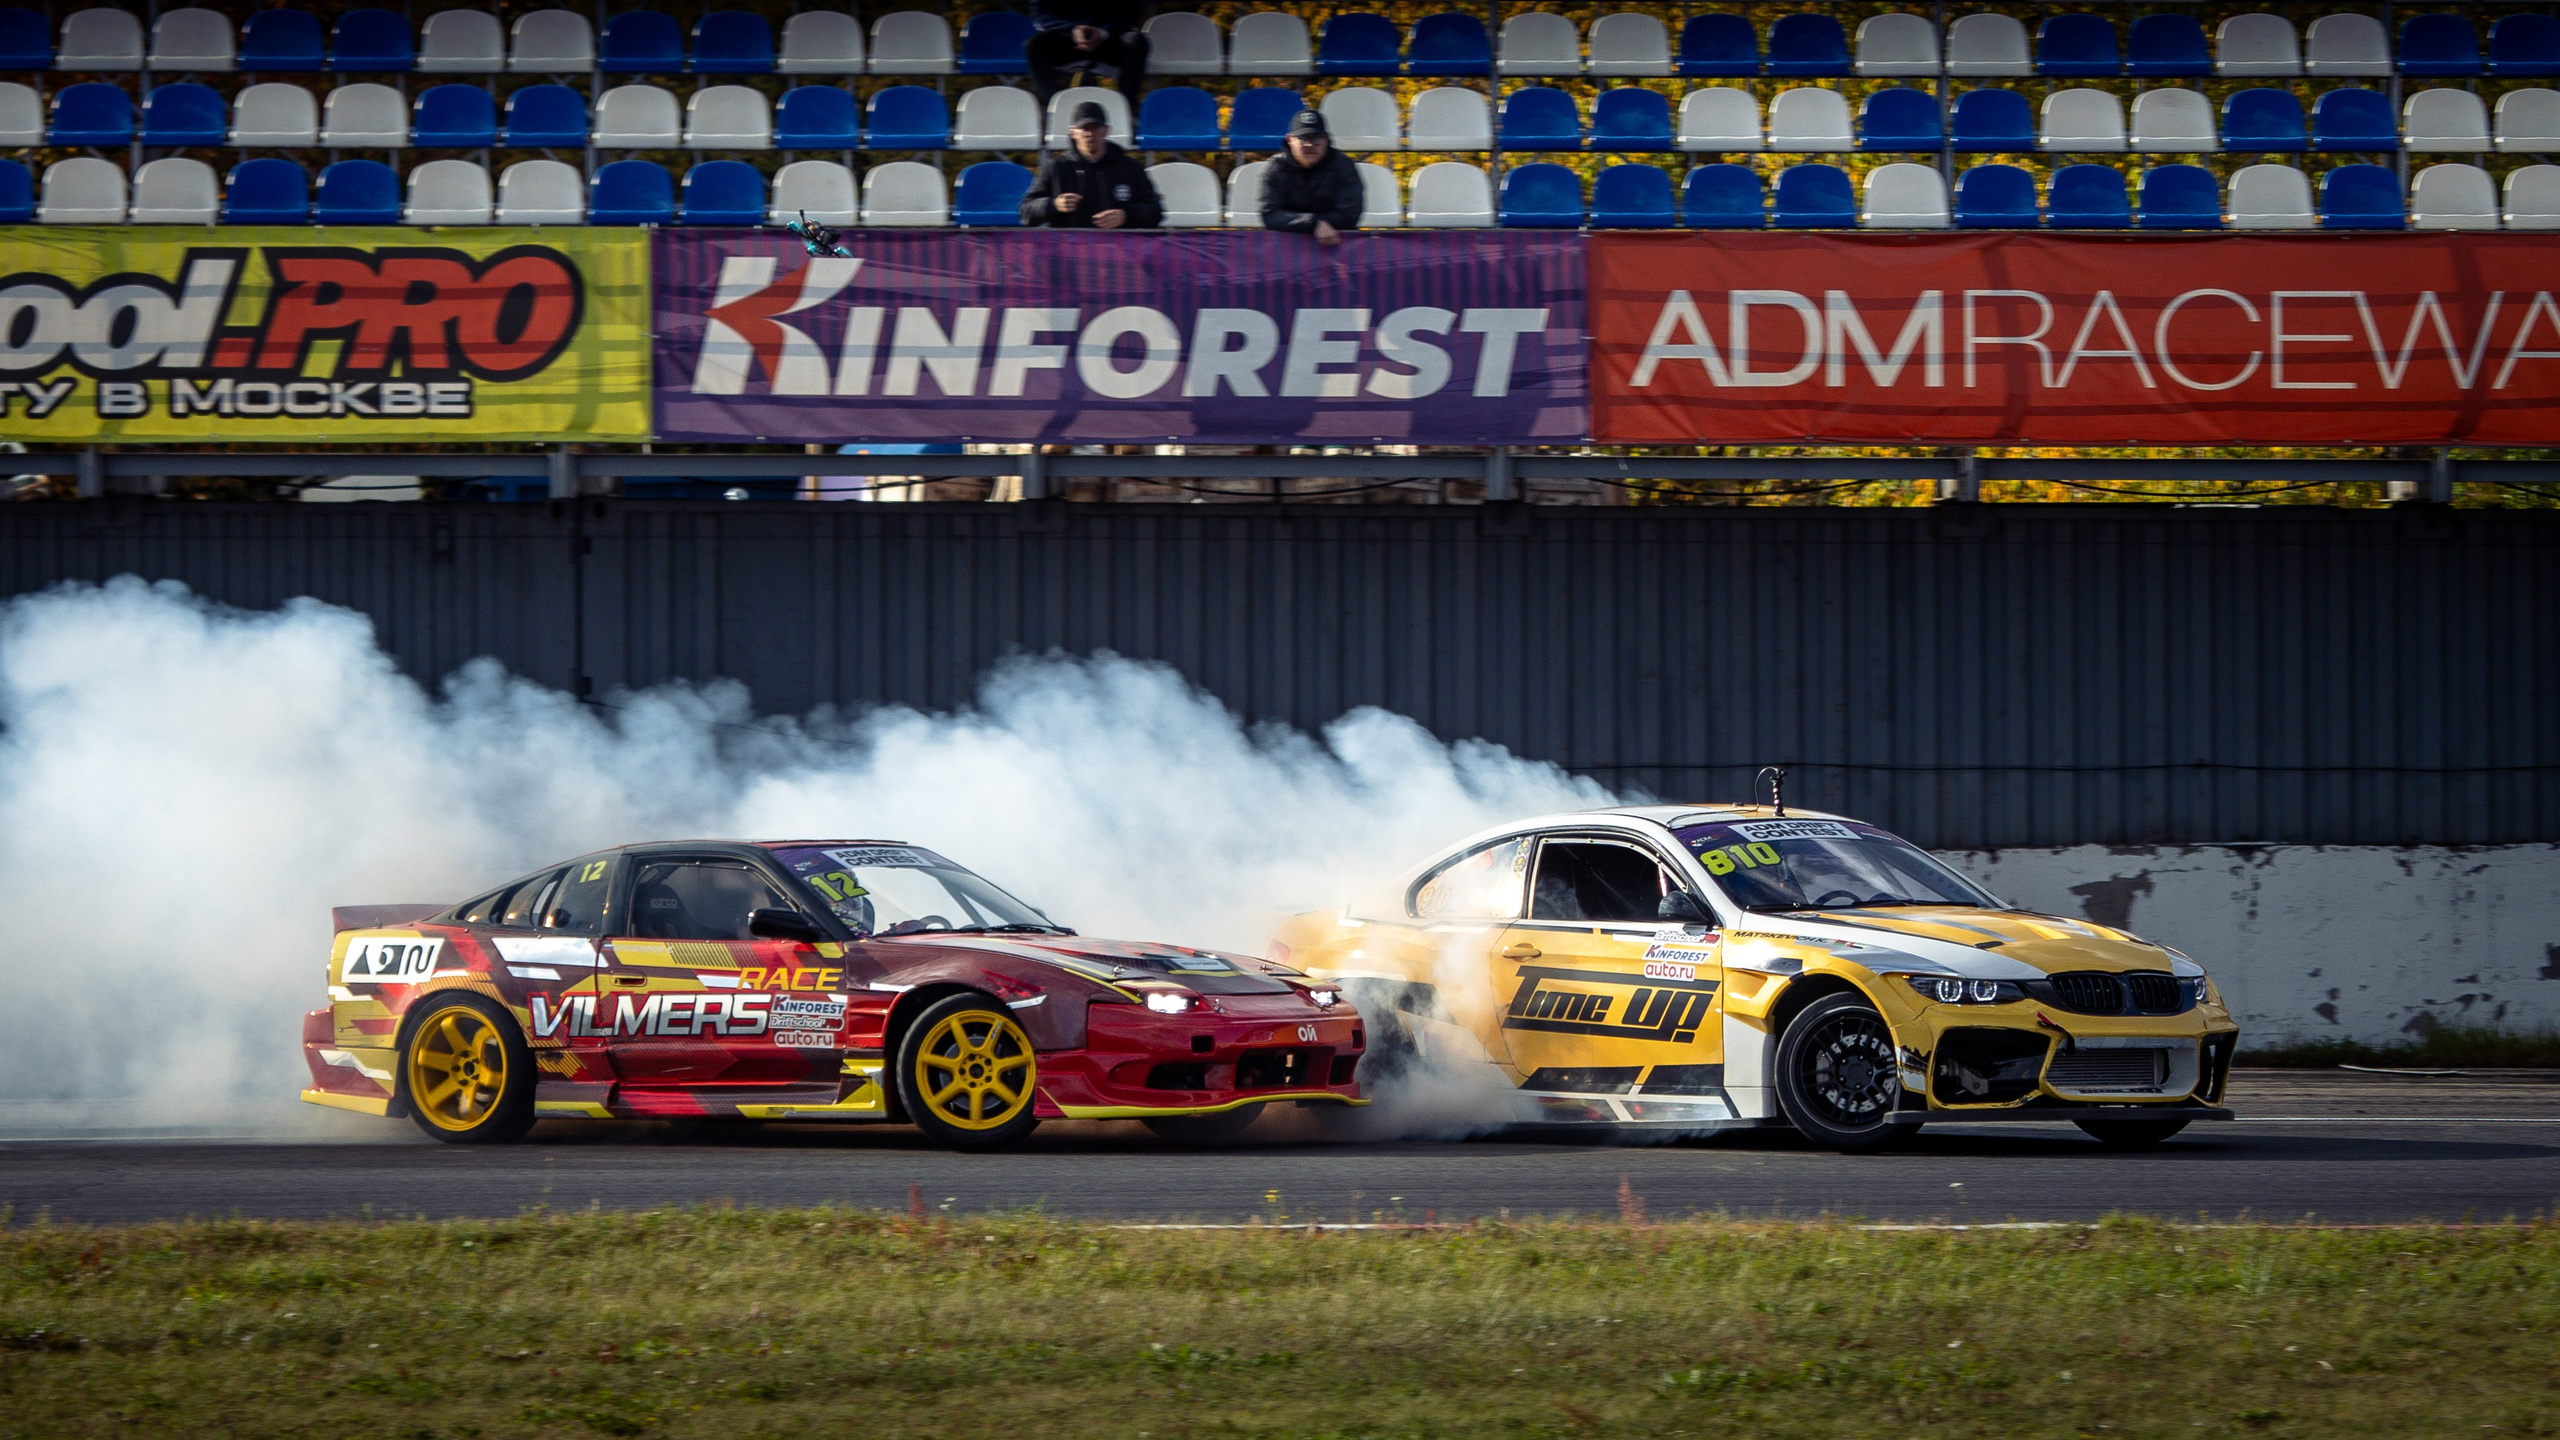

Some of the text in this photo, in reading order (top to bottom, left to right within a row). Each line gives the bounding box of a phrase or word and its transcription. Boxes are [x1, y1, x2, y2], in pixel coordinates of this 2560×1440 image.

[690, 256, 1550, 399] KINFOREST
[100, 380, 148, 414] В
[1743, 822, 1836, 833] ADM DRIFT
[1750, 828, 1848, 839] CONTEST
[835, 849, 873, 858] ADM
[844, 855, 922, 866] CONTEST
[1699, 842, 1781, 876] 810
[579, 861, 607, 883] 12
[810, 871, 869, 901] 12
[1733, 931, 1815, 942] MATSKEVICH
[1645, 944, 1709, 962] KINFOREST
[736, 968, 844, 991] RACE
[1645, 963, 1694, 979] auto.ru
[773, 996, 845, 1014] KINFOREST
[531, 993, 772, 1037] VILMERS
[776, 1031, 833, 1046] auto.ru
